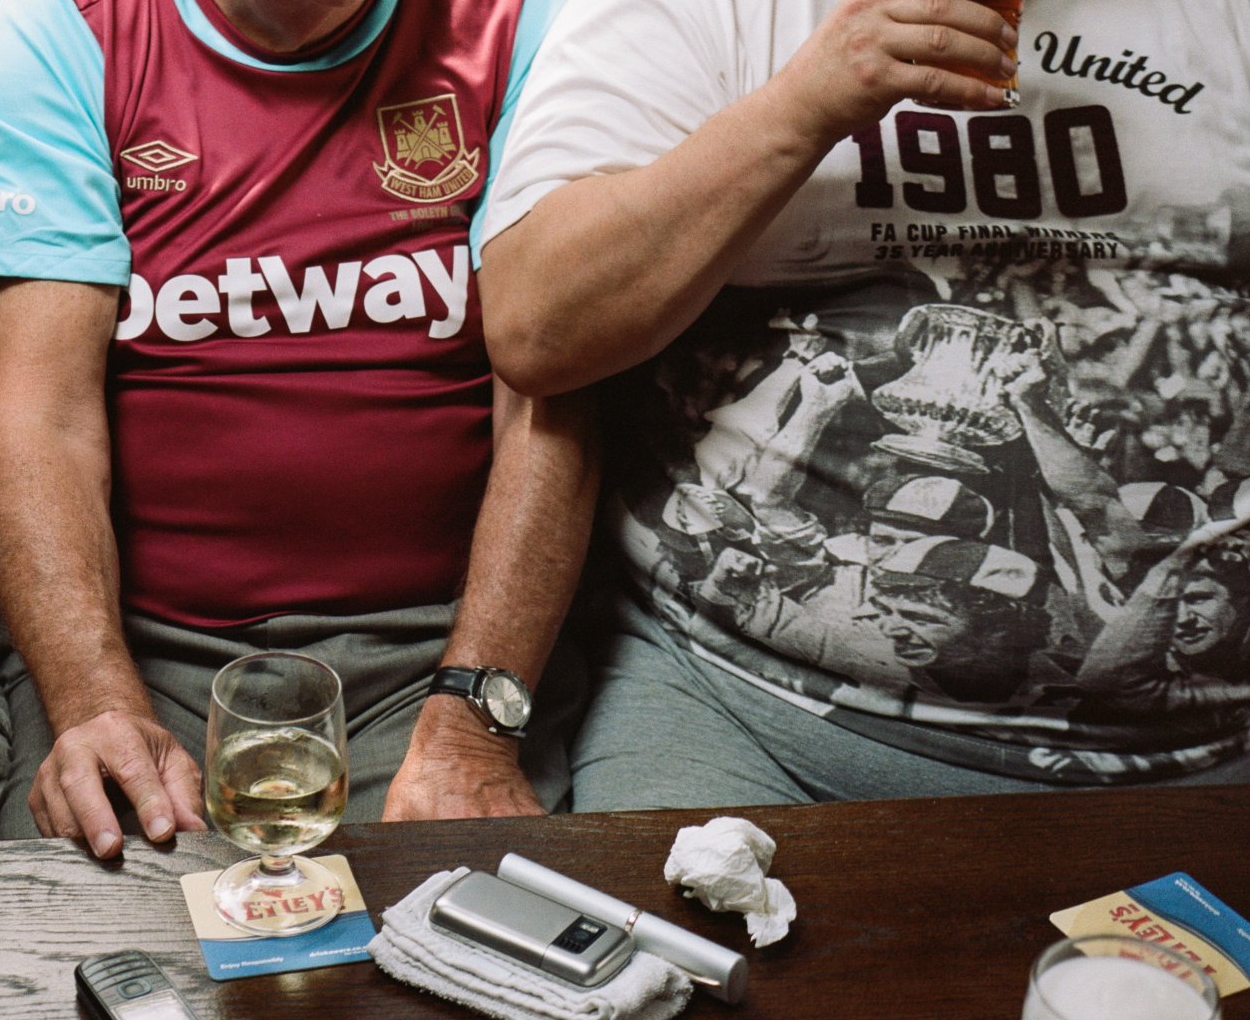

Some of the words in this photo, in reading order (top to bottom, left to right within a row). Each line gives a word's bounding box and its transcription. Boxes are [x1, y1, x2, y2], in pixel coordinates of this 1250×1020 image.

[1033, 30, 1205, 114] United
[851, 104, 1128, 220] 1980
[126, 174, 188, 192] umbro
[390, 177, 417, 197] WEST
[419, 184, 442, 198] HAM
[442, 168, 474, 195] UNITED
[871, 222, 896, 242] FA
[907, 222, 948, 243] CUP
[958, 224, 1017, 240] FINAL
[874, 244, 903, 260] 35
[911, 242, 965, 259] YEAR
[969, 241, 1119, 260] ANNIVERSARY
[218, 886, 347, 921] ETLEY'S
